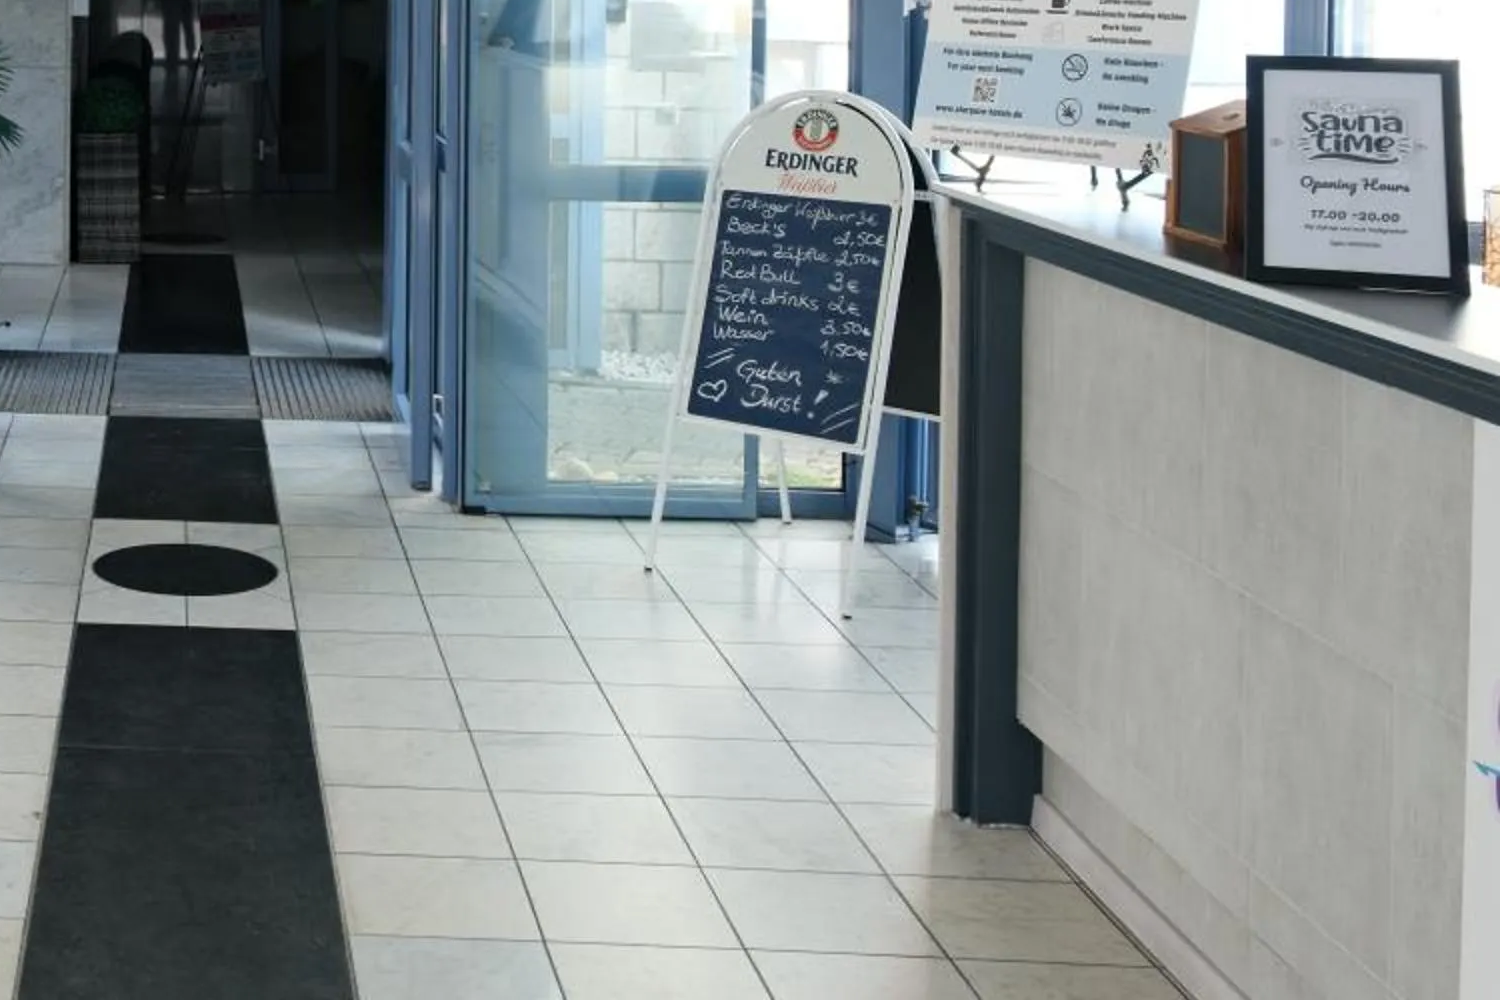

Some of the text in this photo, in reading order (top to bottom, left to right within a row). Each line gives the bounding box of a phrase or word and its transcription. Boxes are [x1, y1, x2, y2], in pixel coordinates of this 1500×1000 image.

[1301, 110, 1404, 134] Sauna
[765, 147, 858, 178] ERDINGER
[1300, 175, 1411, 196] Opening Hours
[726, 193, 793, 219] Erdinger
[727, 216, 787, 239] Beck's
[720, 259, 757, 280] Red
[759, 263, 801, 285] Bull
[714, 284, 757, 305] Soft
[761, 288, 820, 312] drinks
[718, 303, 769, 326] Wein
[713, 321, 775, 342] Wasser
[736, 359, 802, 387] Guten
